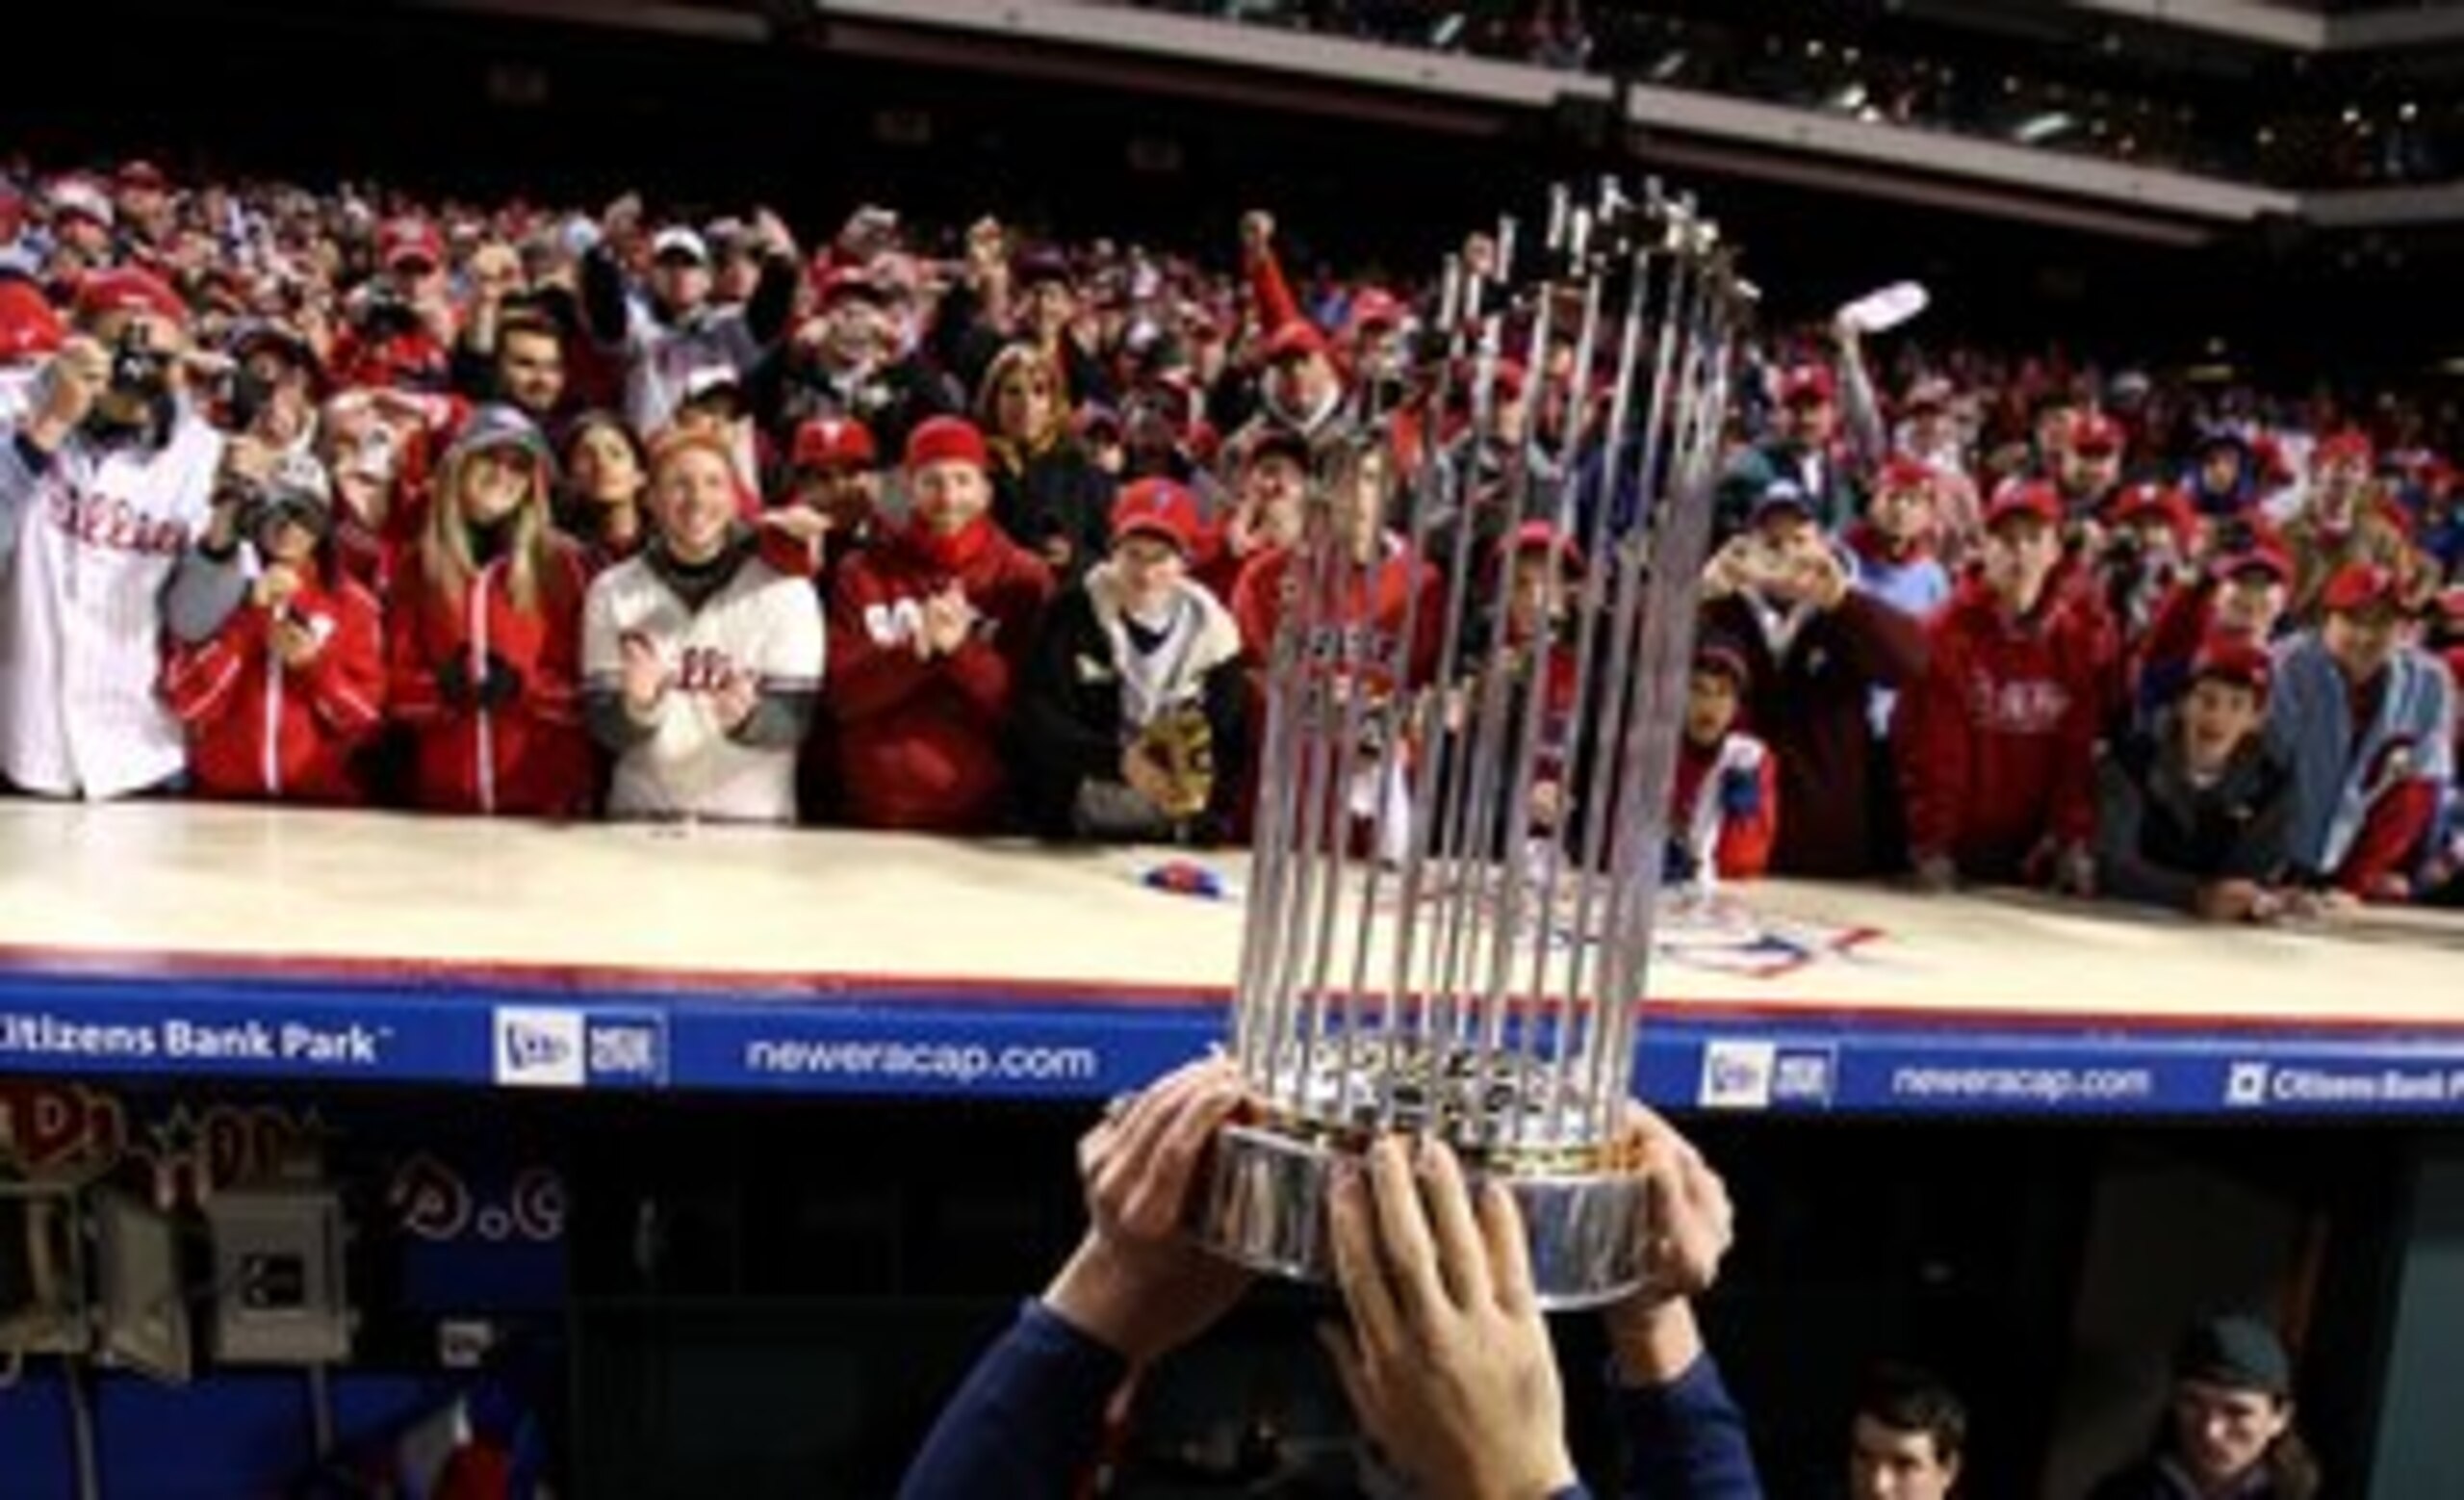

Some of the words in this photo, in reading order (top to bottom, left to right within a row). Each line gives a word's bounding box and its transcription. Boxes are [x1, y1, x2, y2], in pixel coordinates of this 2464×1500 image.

[164, 1020, 273, 1057] Bank
[747, 1041, 1095, 1083] neweracap.com
[1892, 1068, 2151, 1104] neweracap.com
